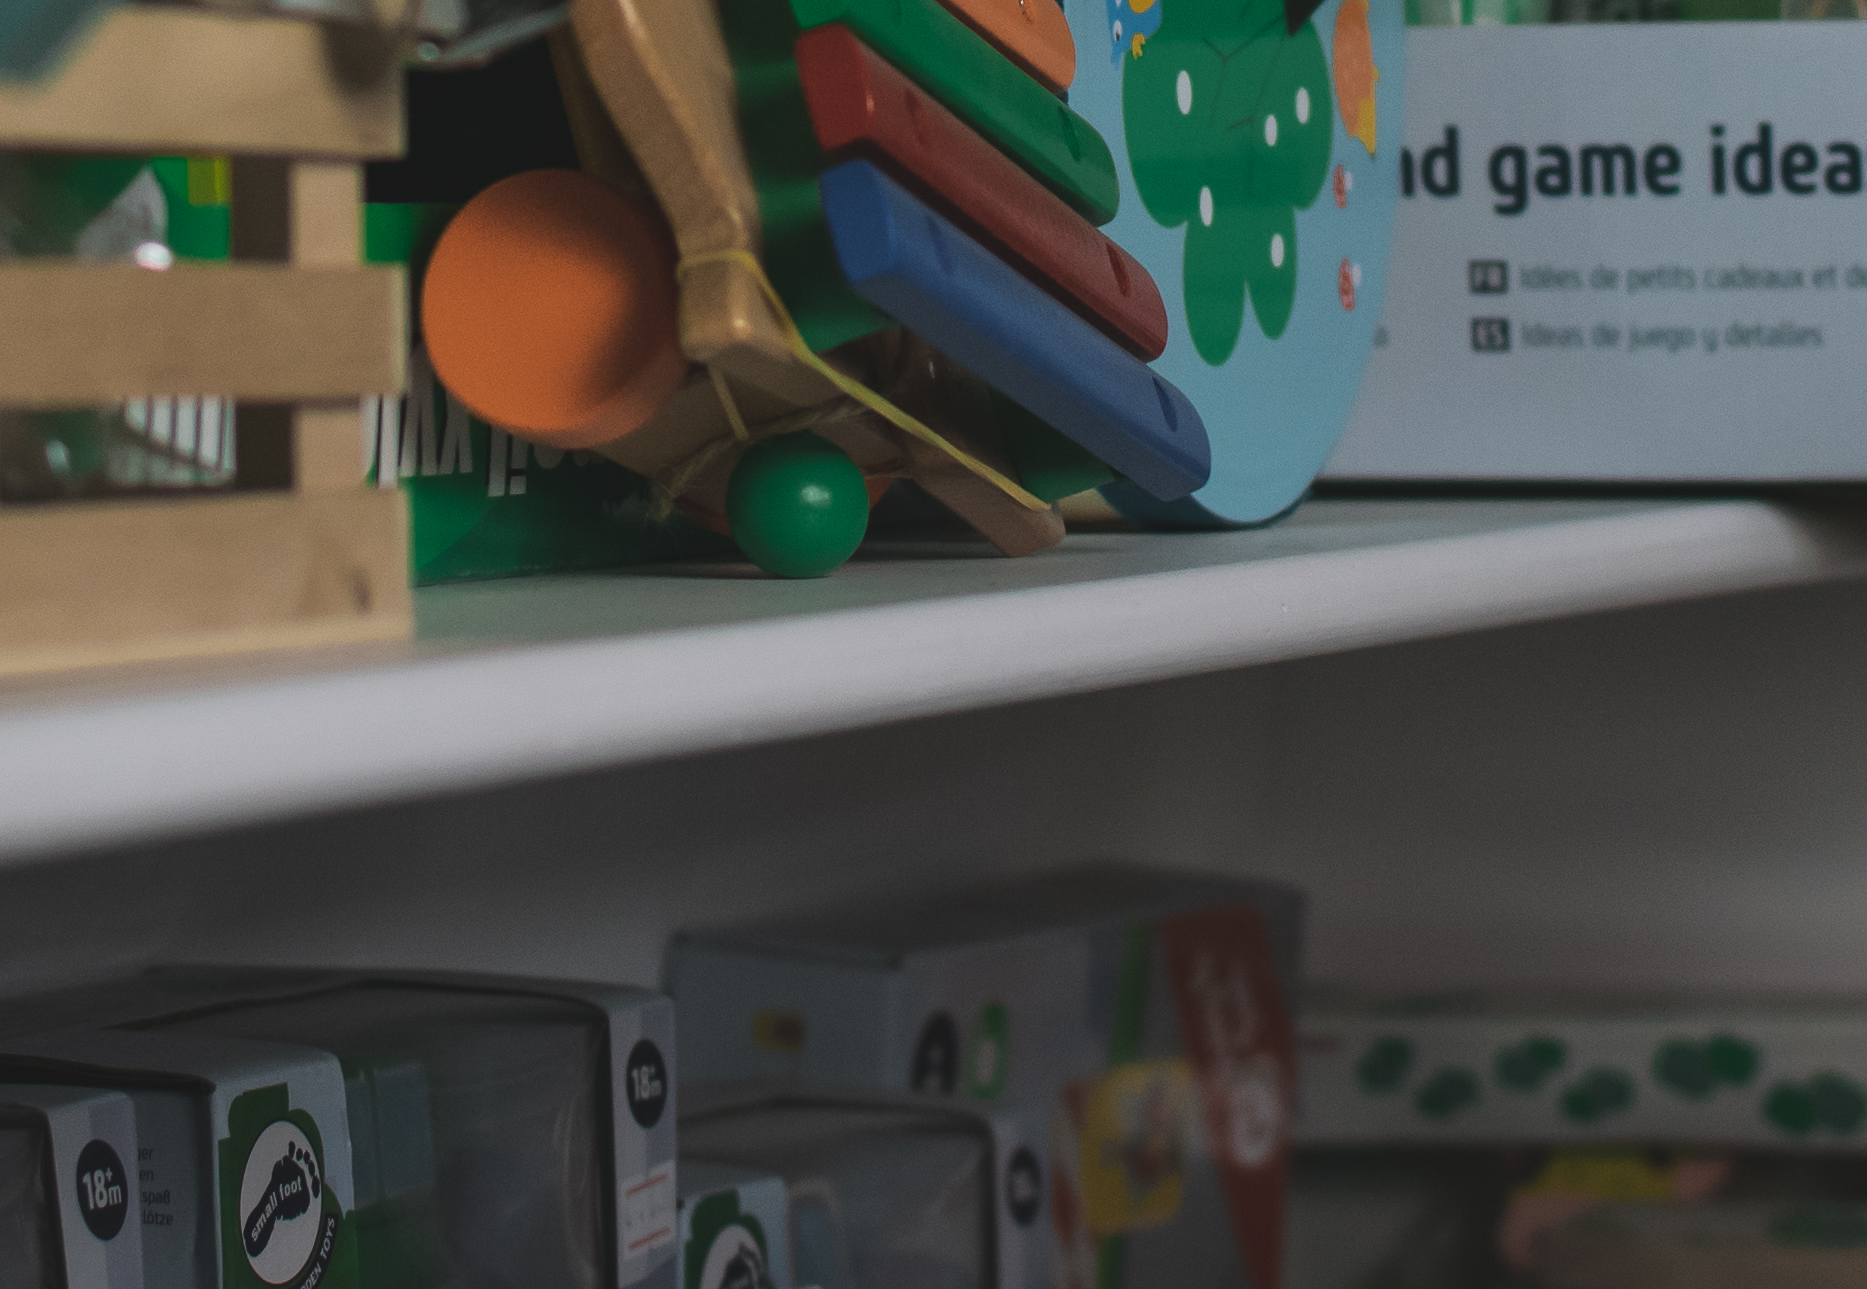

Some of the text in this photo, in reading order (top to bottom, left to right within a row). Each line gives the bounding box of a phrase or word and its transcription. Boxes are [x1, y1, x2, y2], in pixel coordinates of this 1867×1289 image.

[1487, 141, 1683, 217] game
[1519, 262, 1583, 290] Idées
[1589, 264, 1619, 290] de
[1627, 262, 1696, 297] petits
[1703, 263, 1806, 290] cadeaux
[1811, 265, 1837, 289] et
[1521, 322, 1584, 348] Ideas
[1590, 323, 1621, 348] de
[1627, 322, 1696, 355] juego
[1702, 327, 1719, 355] y
[1725, 321, 1824, 348] detalles
[250, 1174, 304, 1244] small foot
[319, 1217, 336, 1261] TOYS
